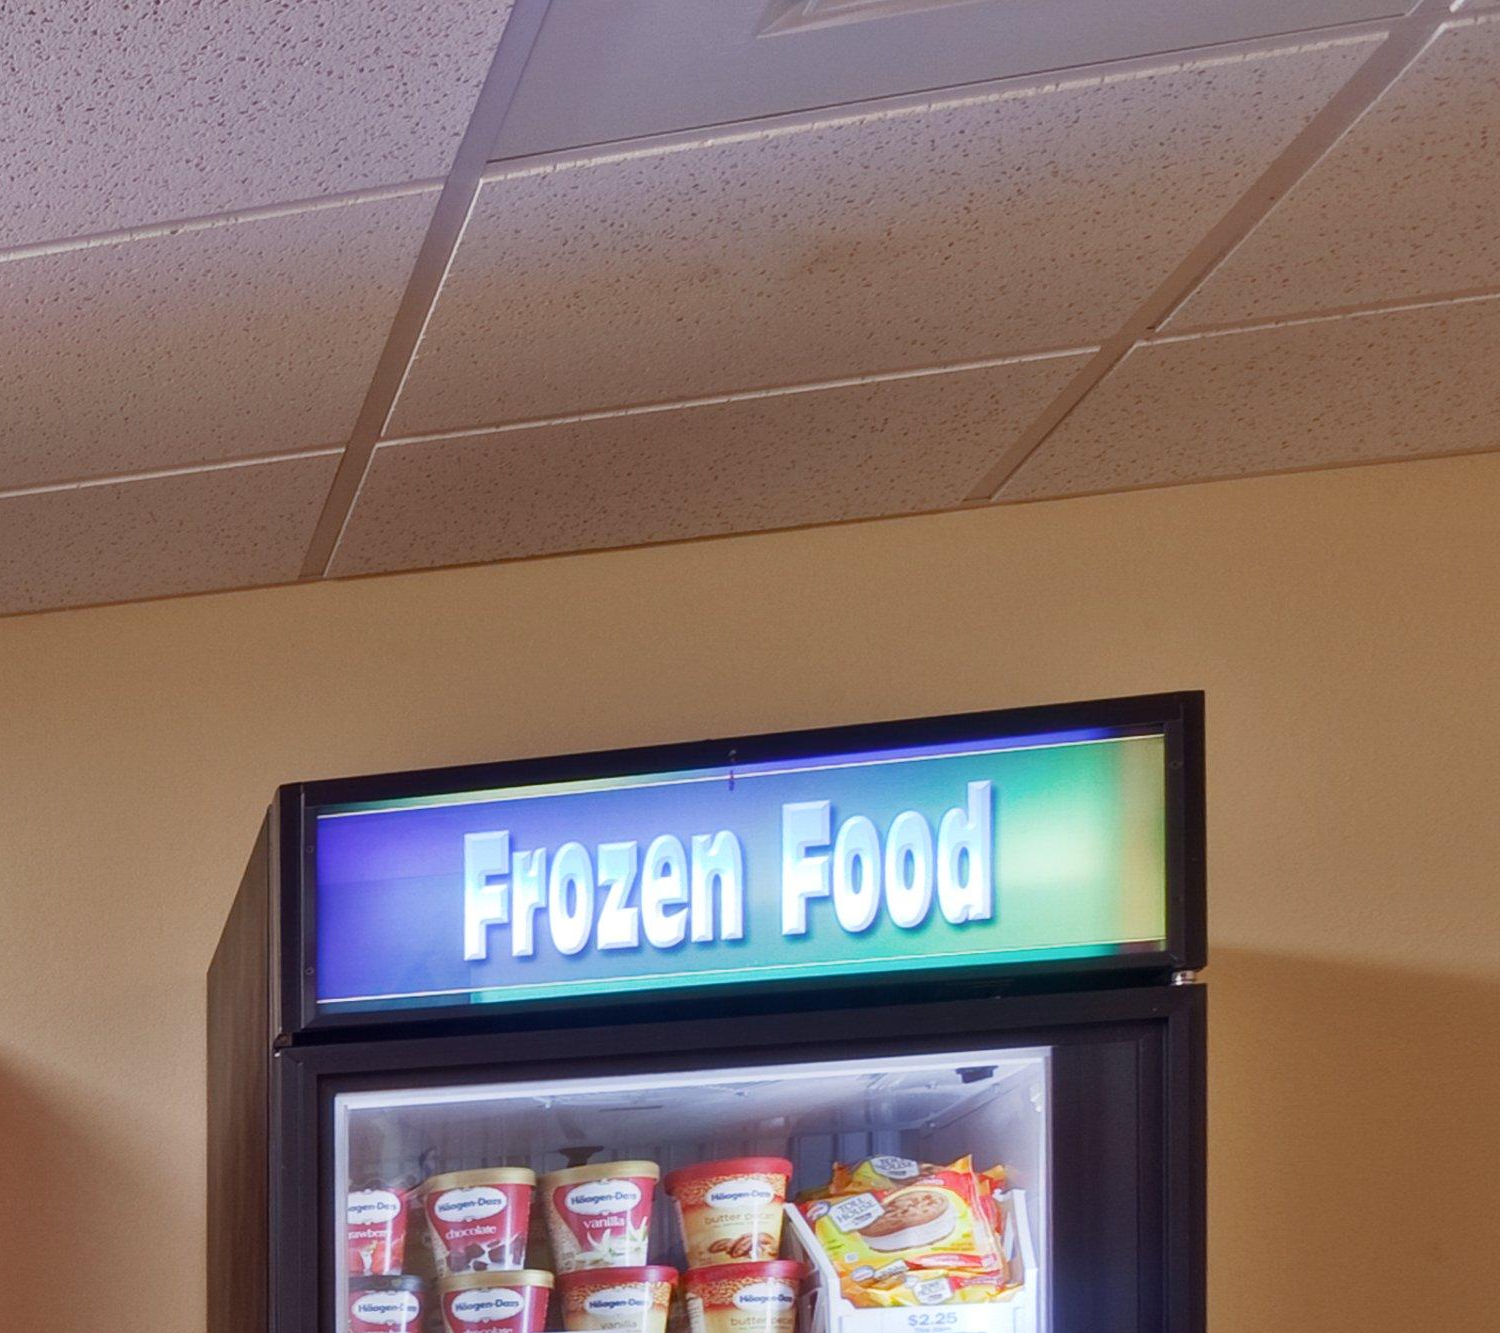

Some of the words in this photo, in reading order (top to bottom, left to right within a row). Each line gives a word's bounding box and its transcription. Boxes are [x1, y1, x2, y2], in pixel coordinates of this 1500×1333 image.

[462, 829, 744, 961] Frozen
[781, 780, 994, 936] Food
[582, 1216, 625, 1229] vanilla
[704, 1213, 741, 1225] butter
[445, 1225, 497, 1239] chocolate
[908, 1312, 958, 1327] $2.25
